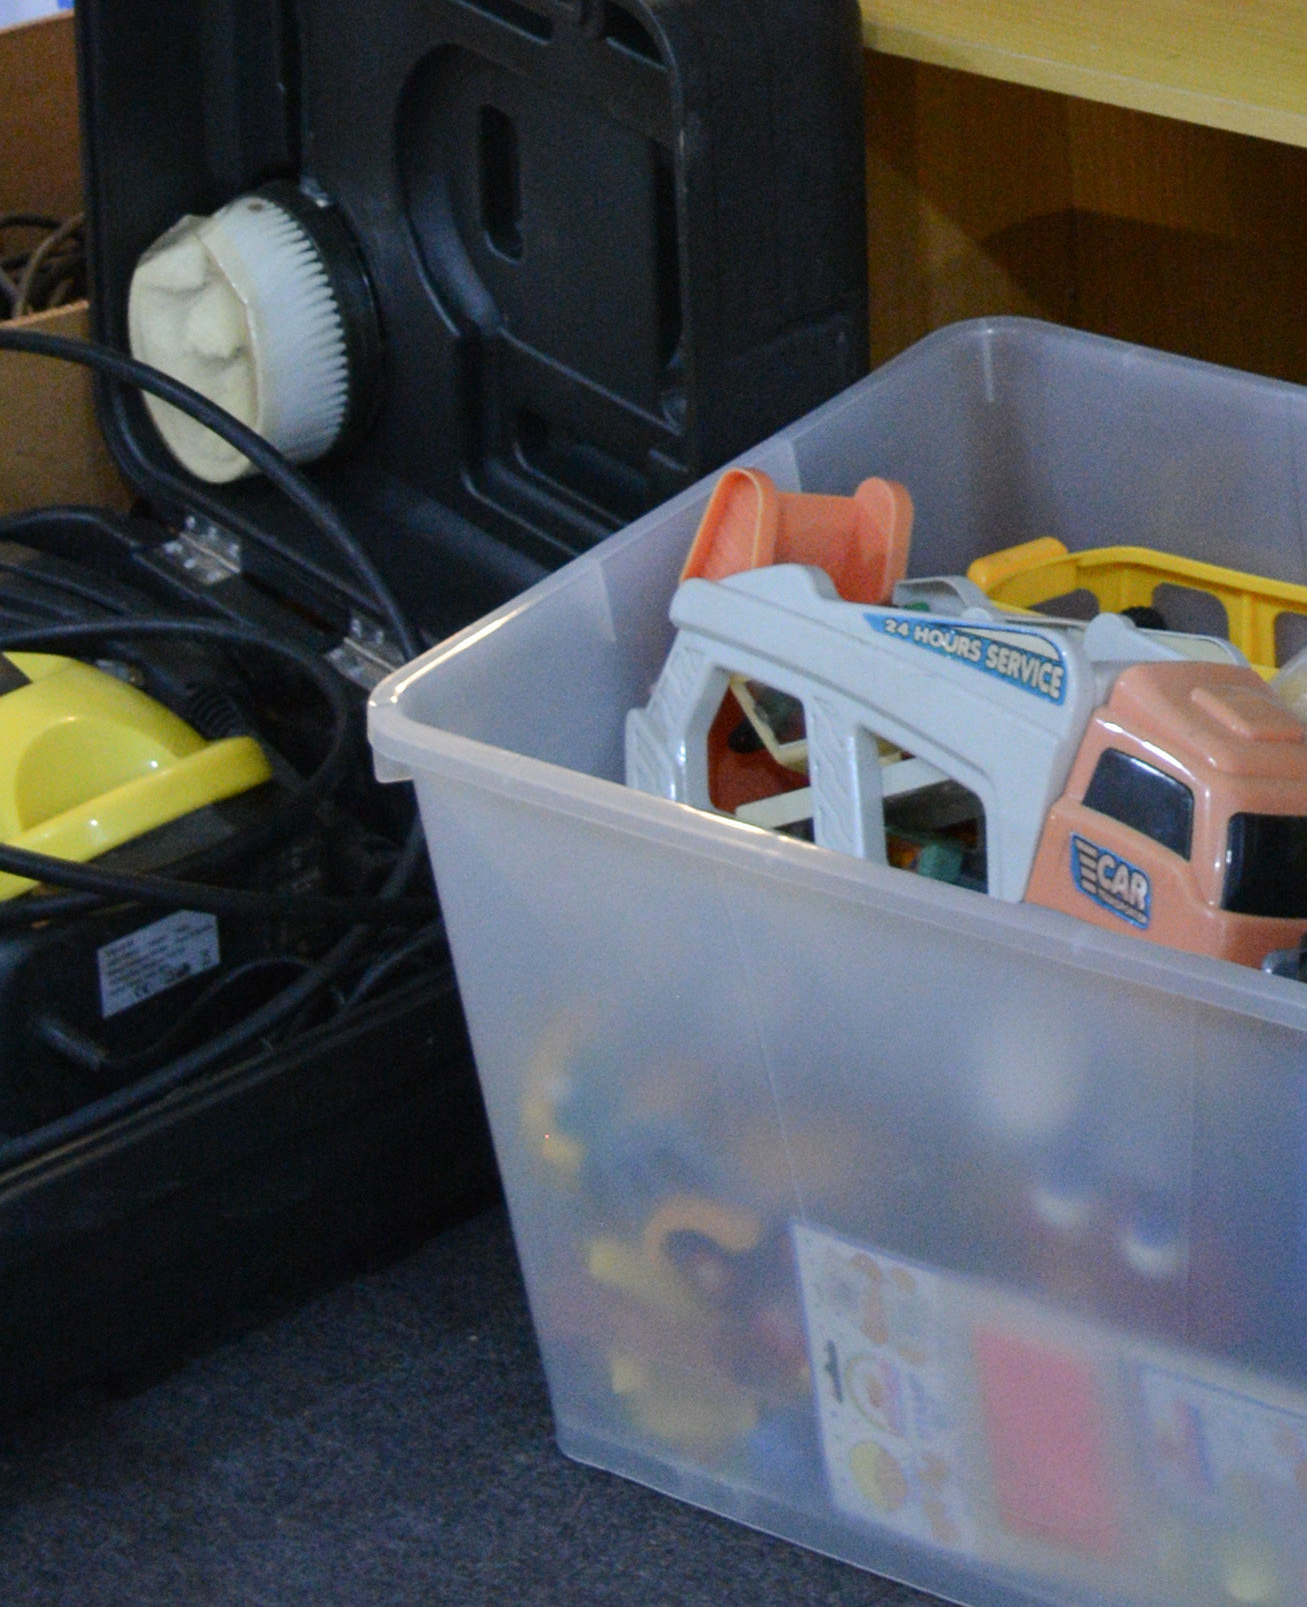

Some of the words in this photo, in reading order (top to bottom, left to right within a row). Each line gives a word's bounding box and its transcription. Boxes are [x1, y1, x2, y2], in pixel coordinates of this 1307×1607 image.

[885, 618, 909, 636] 24
[914, 626, 981, 663] HOURS
[986, 645, 1064, 699] SERVICE
[1097, 853, 1148, 910] CAR
